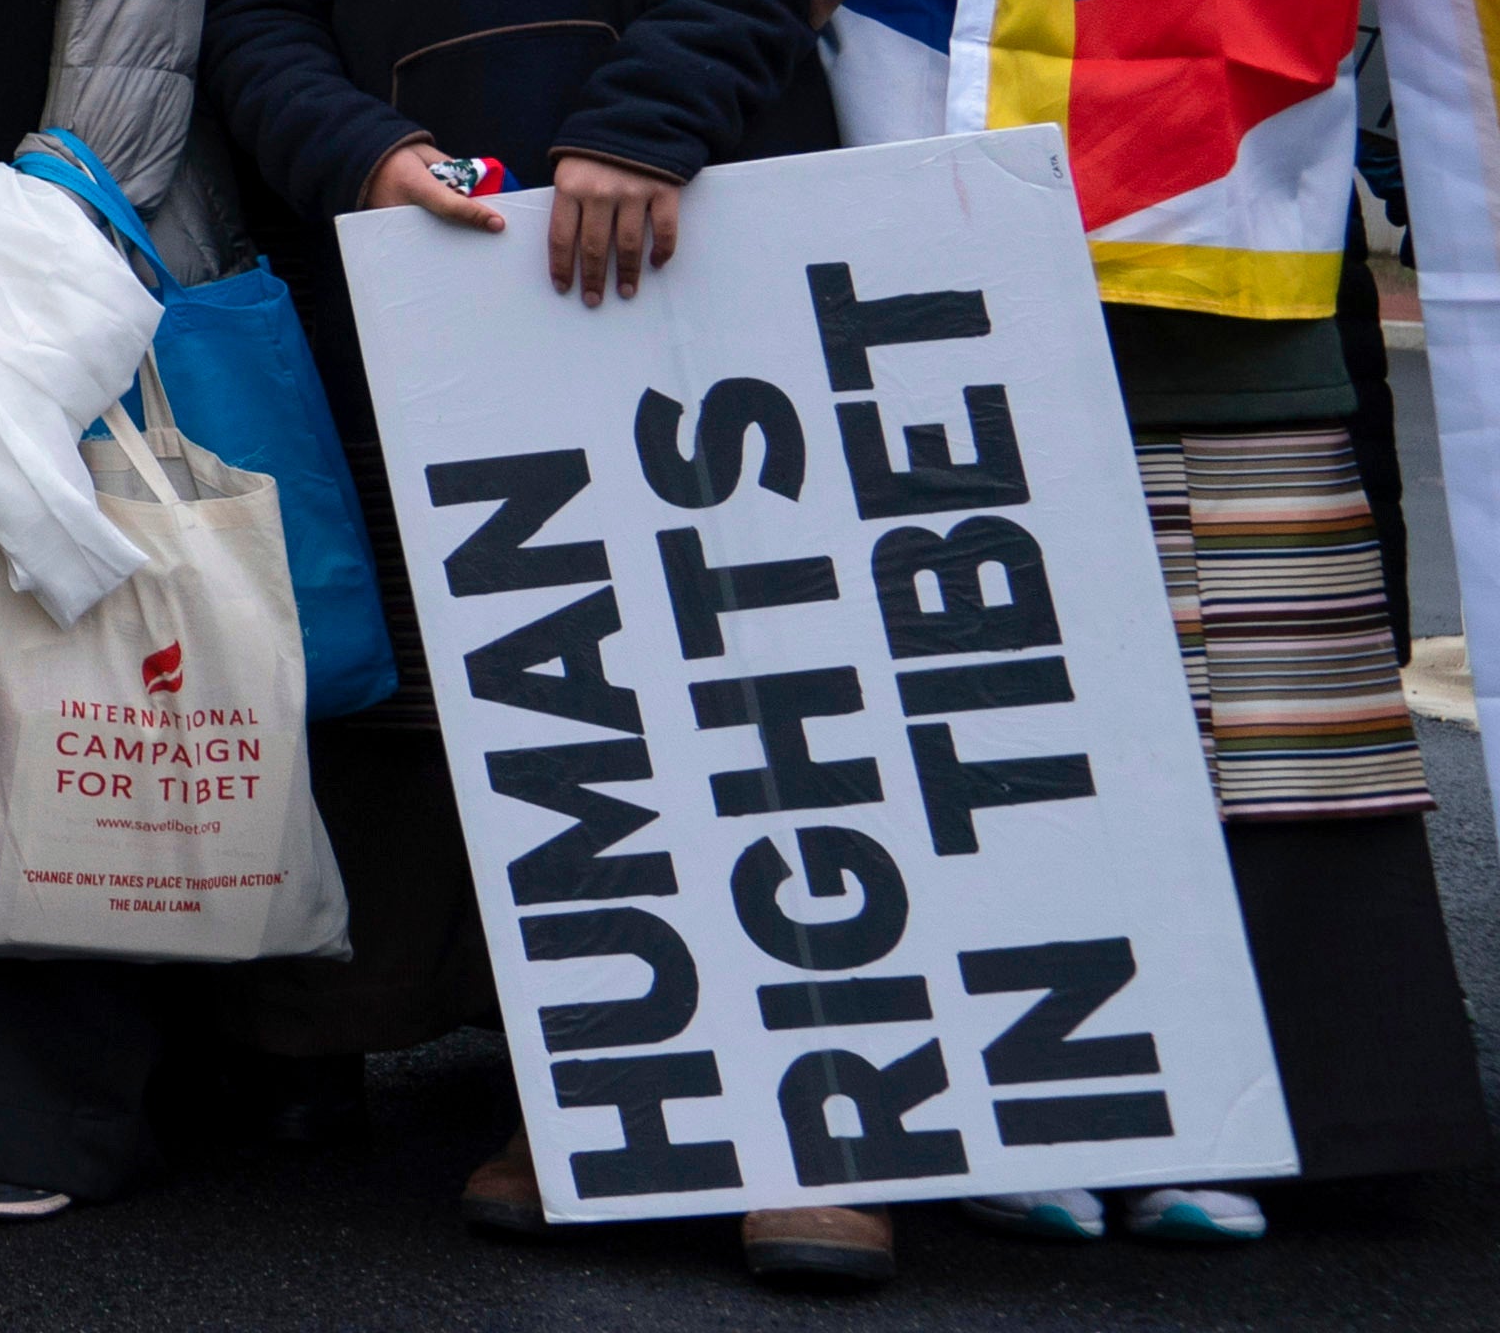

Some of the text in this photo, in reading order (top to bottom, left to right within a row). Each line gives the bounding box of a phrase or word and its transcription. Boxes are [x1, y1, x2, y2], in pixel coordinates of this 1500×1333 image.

[60, 700, 259, 732] INTERNATIONAL
[804, 261, 1175, 1147] IN TIBET
[56, 732, 260, 768] CAMPAIGN
[56, 769, 260, 805] FOR TIBET
[634, 375, 970, 1187] RIGHTS
[96, 817, 221, 835] www.savetibet.org
[424, 447, 743, 1201] HUMAN
[76, 872, 105, 886] ONLY
[109, 874, 144, 888] TAKES
[146, 876, 181, 889] PLACE
[186, 876, 237, 891] THROUGH
[109, 898, 201, 913] THE DALAI LAMA
